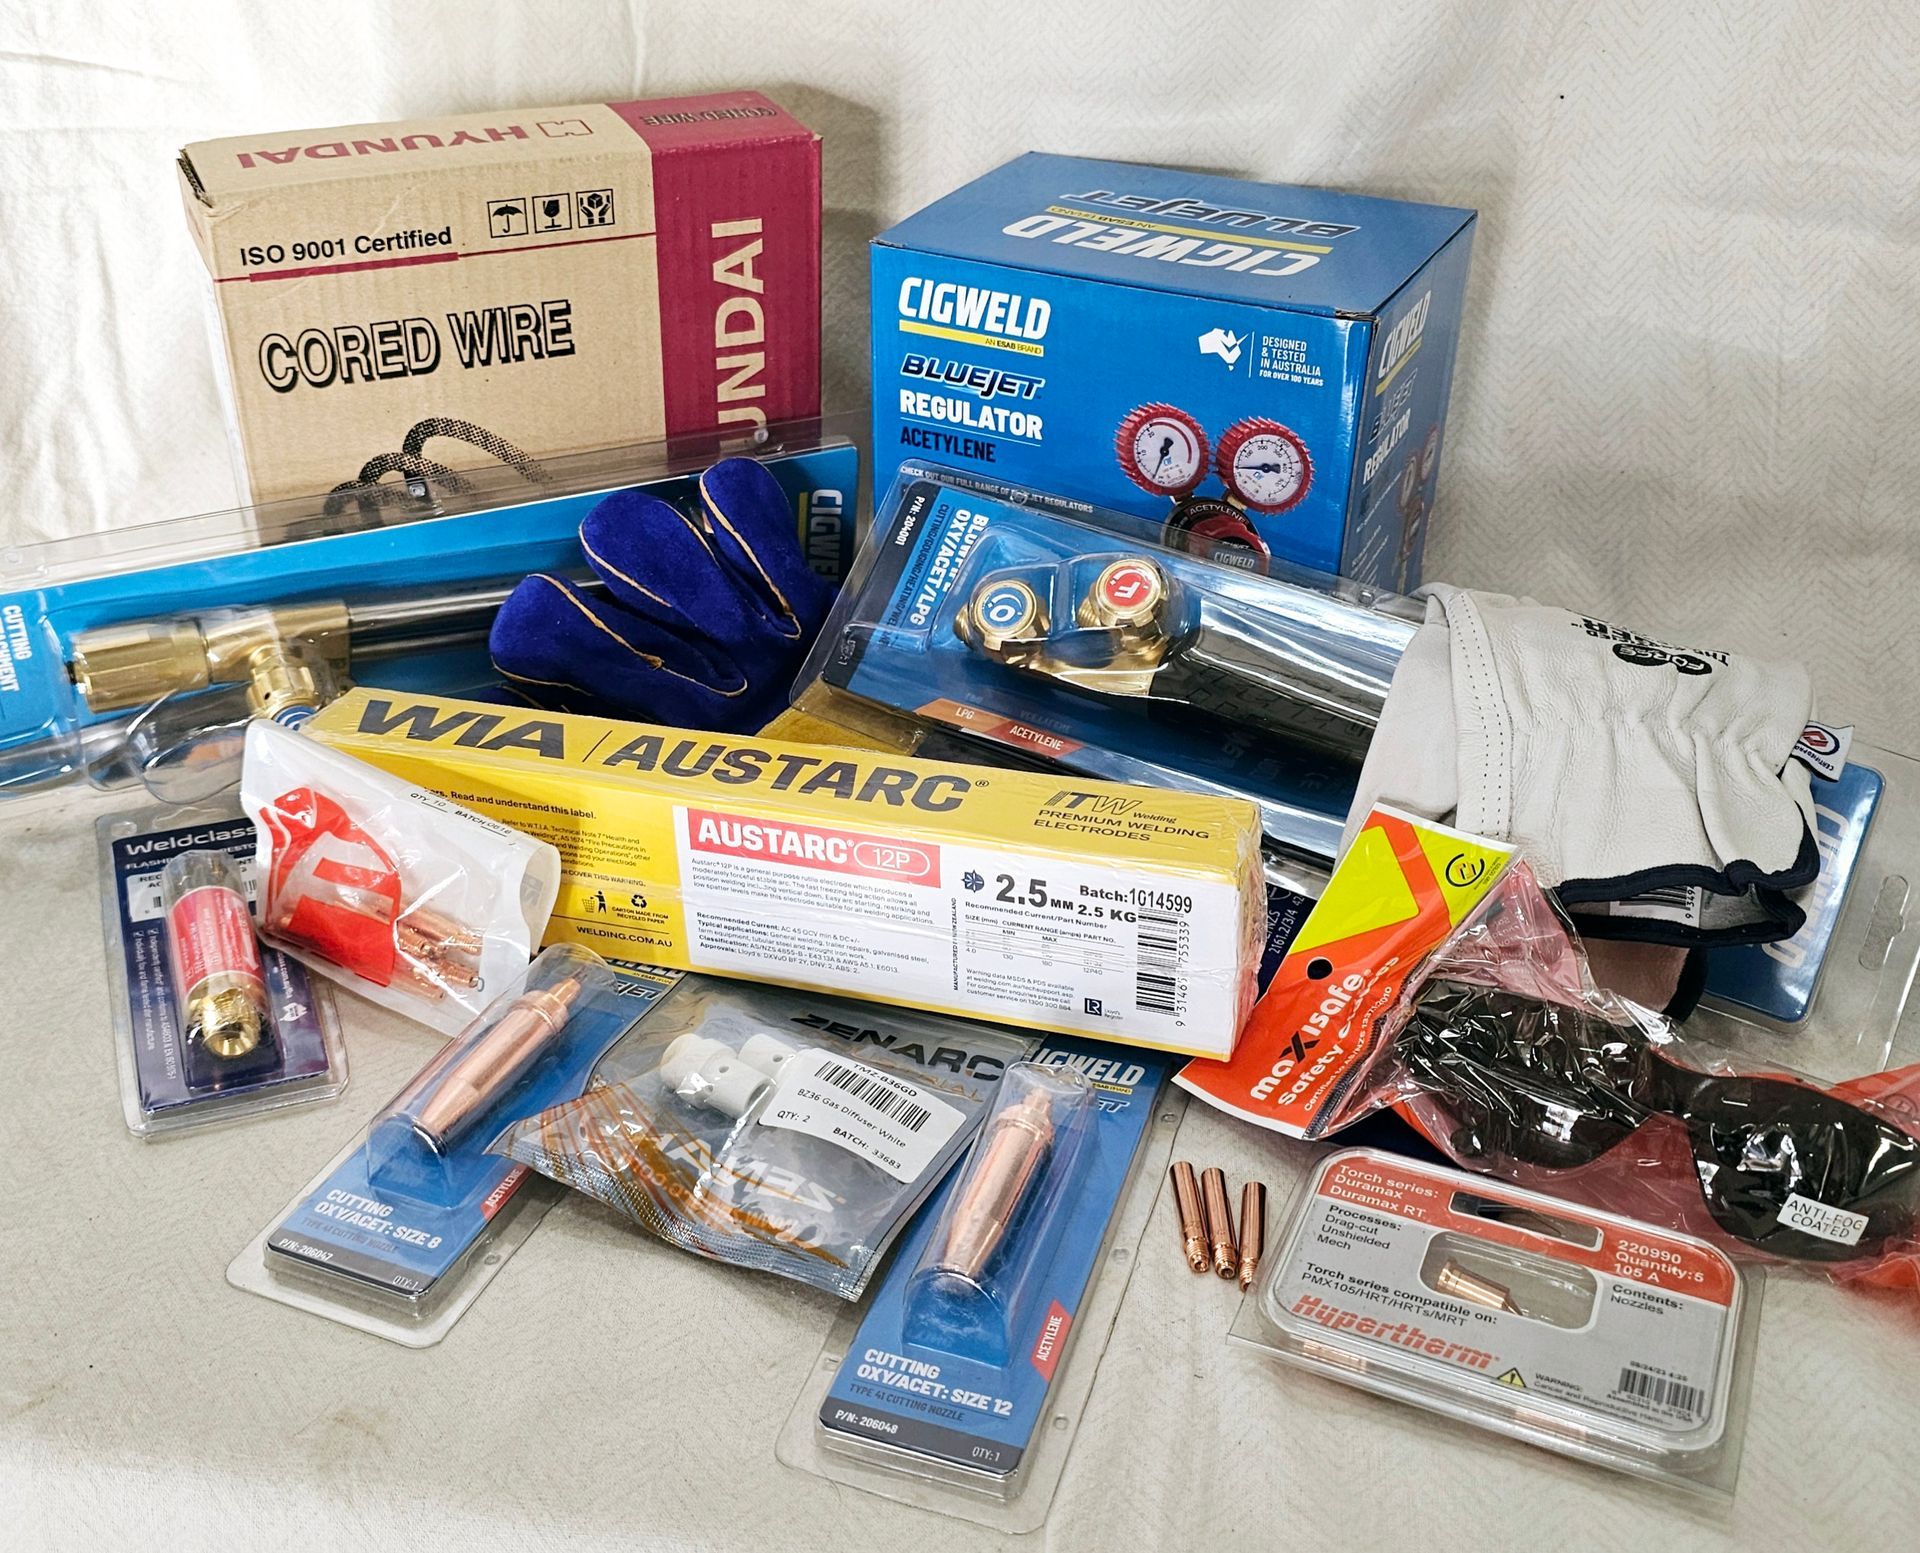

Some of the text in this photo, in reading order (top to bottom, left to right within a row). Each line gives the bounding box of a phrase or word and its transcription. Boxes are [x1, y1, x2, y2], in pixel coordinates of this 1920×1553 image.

[236, 125, 530, 169] HYUNDAI
[1059, 189, 1361, 239] BLUEJET
[240, 226, 453, 266] ISO 9001 Certified
[1002, 214, 1320, 276] CIGWELD
[898, 276, 1051, 340] CIGWELD
[259, 300, 576, 392] CORED WIRE
[711, 218, 768, 453] UNDAI
[985, 338, 1042, 355] AN ESAB BRAND
[1262, 335, 1307, 352] DESIGNED
[1377, 290, 1432, 380] CIGWELD
[1260, 358, 1321, 377] IN AUSTRALIA
[1261, 347, 1306, 363] & TESTED
[900, 353, 1046, 400] BLUEJET
[1259, 369, 1324, 387] FOR OVER 100 YEARS
[900, 389, 1043, 440] REGULATOR
[900, 426, 997, 463] ACETYLENE
[1363, 408, 1411, 485] REGULATOR
[900, 465, 1094, 514] CHECK OUT OUR FULL RANGE OF REGULATORS
[895, 496, 926, 546] P/N: 204001
[1189, 504, 1251, 526] ACETYLENE
[809, 489, 842, 582] CIGWE
[910, 509, 971, 626] OXY/ACET/LPG
[1213, 551, 1255, 570] CIGWELD
[1114, 580, 1141, 599] F
[2, 604, 33, 661] CUTTING
[955, 706, 975, 721] LPG
[357, 699, 565, 760] WIA
[1009, 724, 1064, 752] ACETYLENE
[1807, 750, 1835, 772] CERTIFIED
[450, 790, 597, 820] Read and understand this label.
[454, 810, 486, 826] BATCH
[1043, 790, 1178, 824] ITW Welding
[551, 824, 640, 845] Technical Note and
[1033, 819, 1151, 842] ELECTRODES
[1038, 809, 1210, 839] PREMIUM WELDING
[126, 824, 257, 857] Weldclass
[601, 839, 640, 852] Precautions
[606, 856, 637, 867] electrode
[873, 847, 911, 869] 12P
[611, 906, 635, 915] CARTON
[635, 909, 651, 917] MADE
[995, 873, 1137, 923] 2.5 MM 2.5 KG
[696, 911, 780, 931] Recommended Current:
[697, 919, 769, 937] Typical applications:
[965, 901, 1108, 930] Recommended Current/Part Number
[965, 913, 1117, 944] SIZE (mm) CURRENT RANGE (amps) PART NO.
[576, 925, 673, 948] WELDING.COM.AU
[698, 934, 749, 948] Classification:
[1041, 935, 1058, 943] MAX
[1178, 920, 1190, 964] 755339
[966, 967, 1075, 992] Warning available
[790, 1013, 1005, 1082] ZENARC
[853, 1063, 918, 1098] TMZ-B36GD
[1033, 1047, 1146, 1087] IGWELD
[1278, 1044, 1345, 1106] Safety
[1304, 1071, 1336, 1112] Certified
[1344, 1030, 1366, 1066] AS/NZS
[777, 1110, 811, 1123] QTY: 2
[797, 1088, 907, 1149] BZ36 Gas Diffuser White
[833, 1126, 902, 1171] BATCH: 33683
[484, 1168, 523, 1210] ACETYLENE
[1334, 1174, 1404, 1200] Duramax
[1338, 1164, 1439, 1199] Torch series:
[326, 1188, 394, 1218] CUTTING
[1329, 1185, 1428, 1219] Duramax RT
[1787, 1200, 1864, 1232] ANTI-FOG
[314, 1201, 443, 1250] OXY/ACET: SIZE 8
[1325, 1213, 1379, 1236] Drag-cut
[1329, 1204, 1402, 1232] Processes:
[1791, 1213, 1850, 1238] COATED
[278, 1237, 333, 1262] P/N: 206047
[1316, 1234, 1352, 1251] Mech
[1321, 1224, 1391, 1250] Unshielded
[1617, 1239, 1682, 1265] 220990
[392, 1275, 412, 1289] QTY:
[1614, 1263, 1660, 1283] 105 A
[1301, 1272, 1469, 1327] PMX105/HRT/HRTs/MRT
[1306, 1262, 1498, 1325] Torch series compatible on:
[1610, 1294, 1664, 1315] Nozzles
[1612, 1283, 1684, 1310] Contents:
[1036, 1315, 1063, 1362] ACETYLENE
[1291, 1294, 1496, 1370] Hypertherm
[864, 1348, 941, 1379] CUTTING
[857, 1363, 1014, 1416] OXY/ACET: SIZE 12
[1534, 1380, 1564, 1396] Cancer
[1535, 1372, 1583, 1392] WARNING:
[834, 1409, 899, 1435] P/N: 206048
[886, 1393, 965, 1422] CUTTING NOZZLE
[972, 1446, 1001, 1462] QTY: 1
